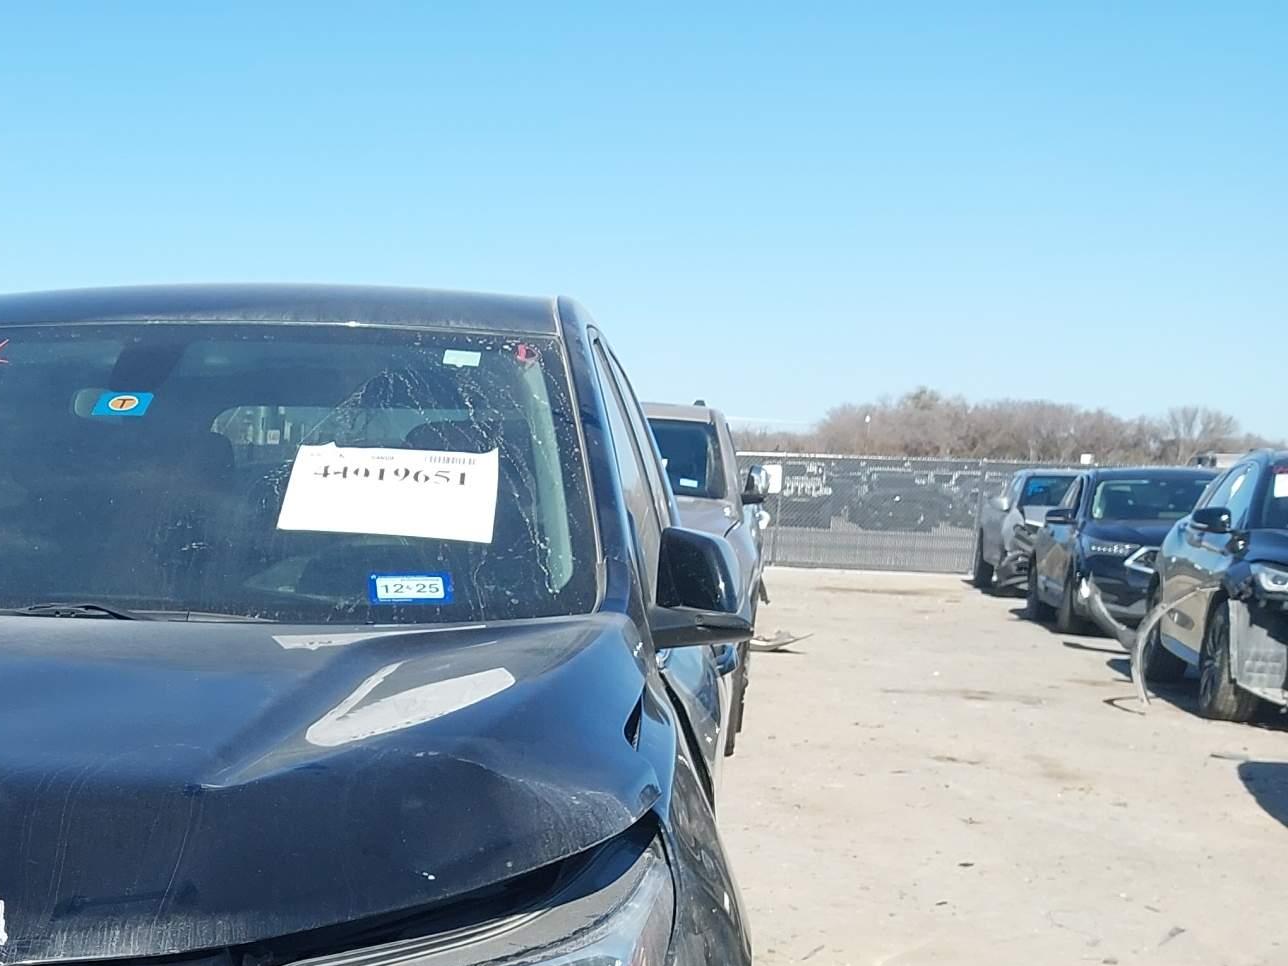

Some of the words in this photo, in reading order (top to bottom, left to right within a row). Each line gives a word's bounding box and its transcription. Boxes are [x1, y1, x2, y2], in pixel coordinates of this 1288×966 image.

[313, 464, 467, 486] 44019651
[382, 583, 404, 594] 12
[415, 583, 440, 594] 25
